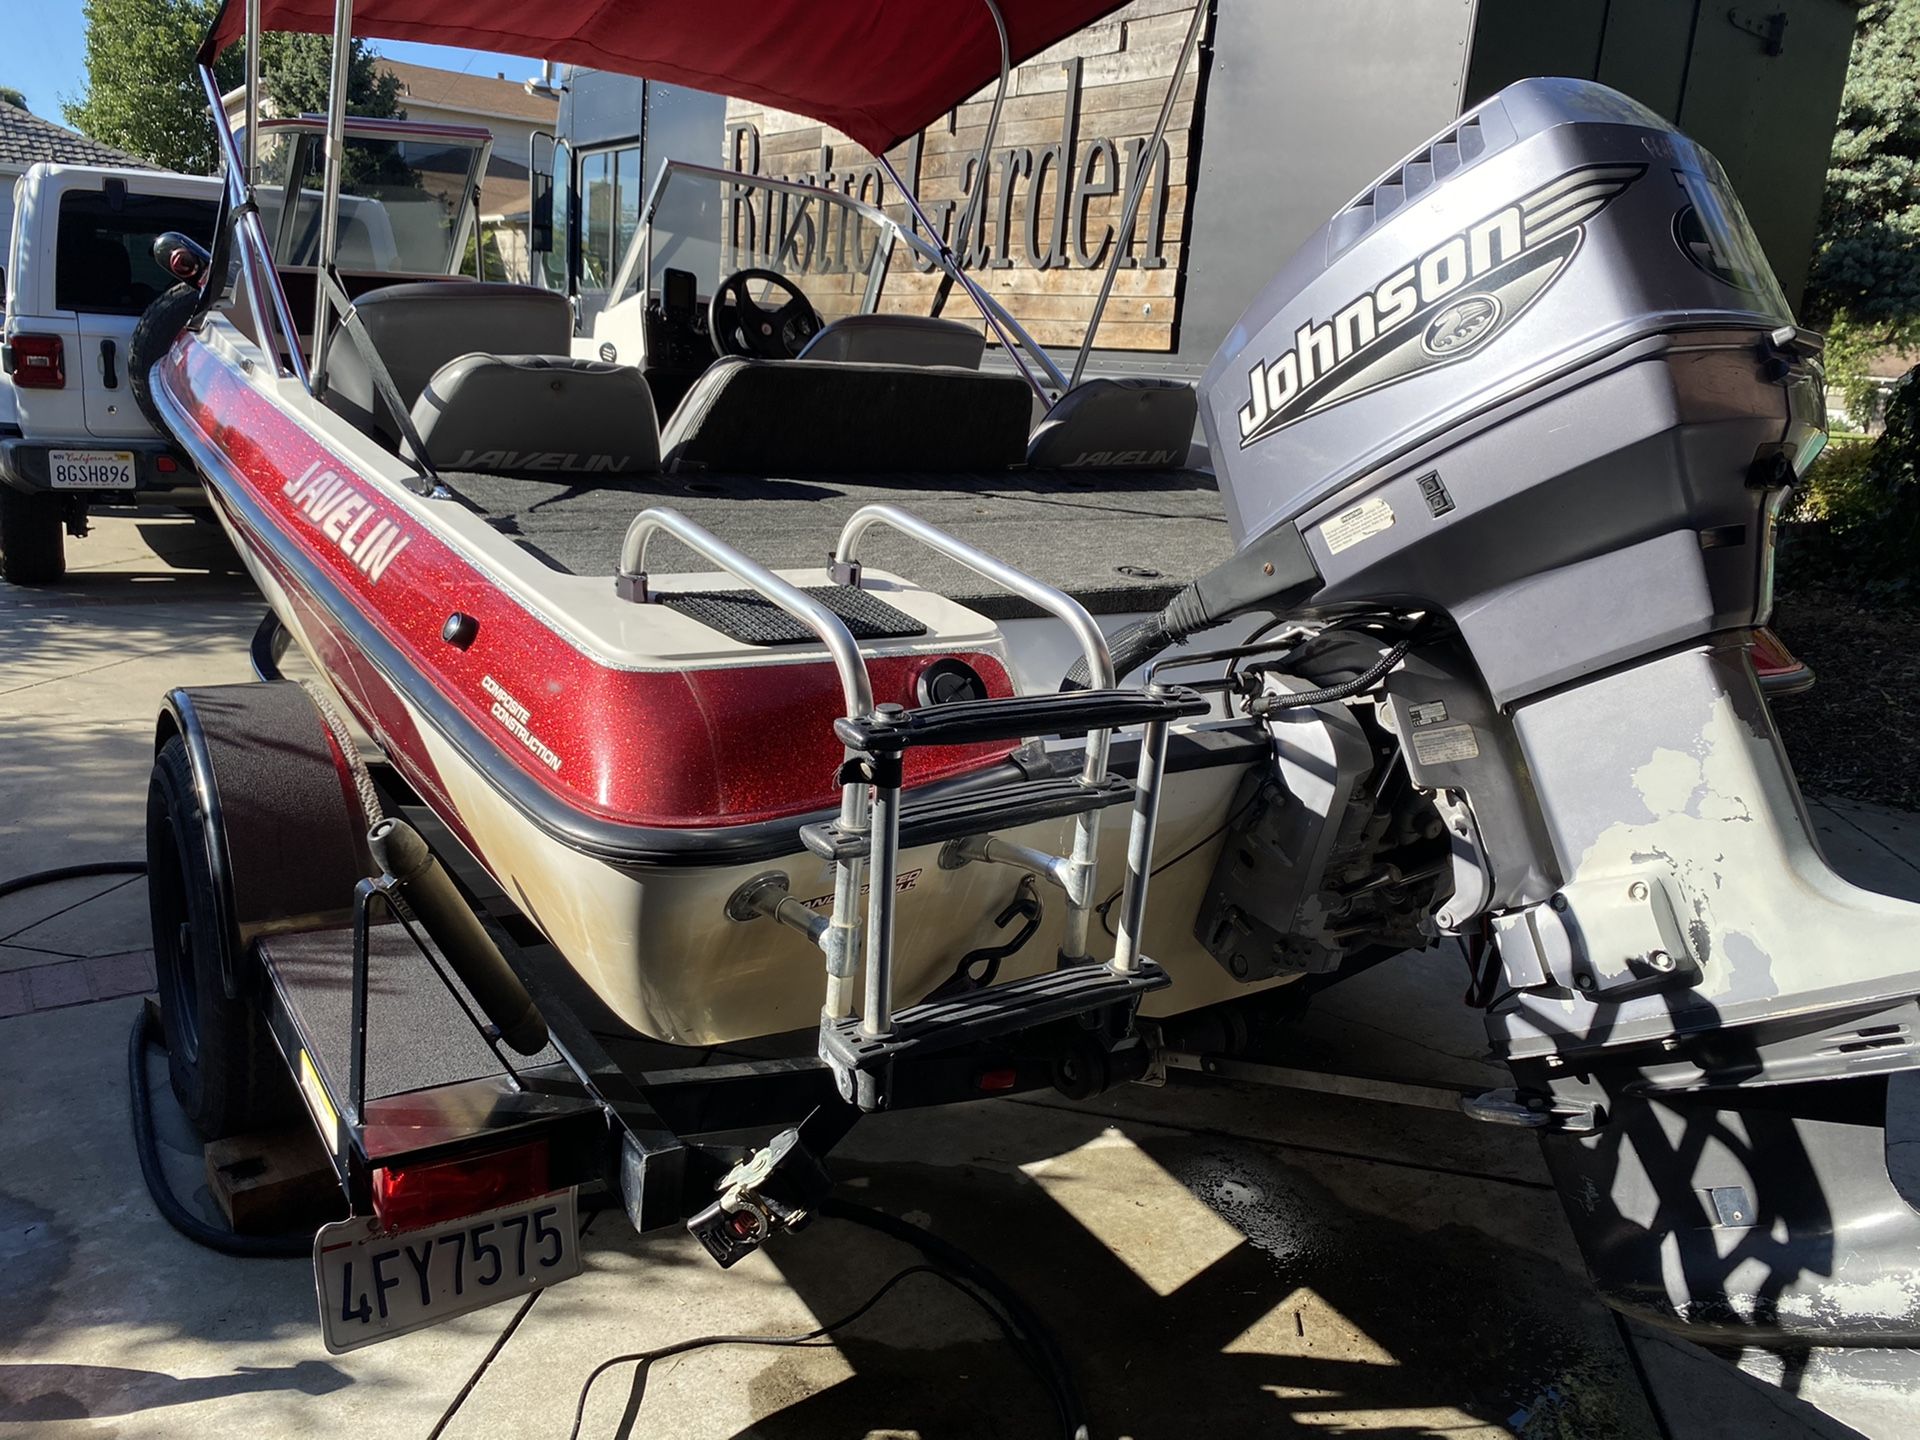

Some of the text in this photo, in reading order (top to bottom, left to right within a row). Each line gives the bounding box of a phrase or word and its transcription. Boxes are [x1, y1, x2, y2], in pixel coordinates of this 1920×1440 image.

[905, 56, 1168, 273] Garden
[1238, 206, 1523, 438] Johnson
[56, 464, 130, 483] 8GSH896
[66, 452, 113, 464] California
[435, 449, 631, 473] JAVELIN
[1060, 449, 1179, 467] JAVELIN
[282, 459, 413, 586] JAVELIN
[481, 675, 532, 725] COMPOSITE
[491, 702, 562, 772] CONSTRUCTION
[342, 1206, 563, 1324] 4FY7575
